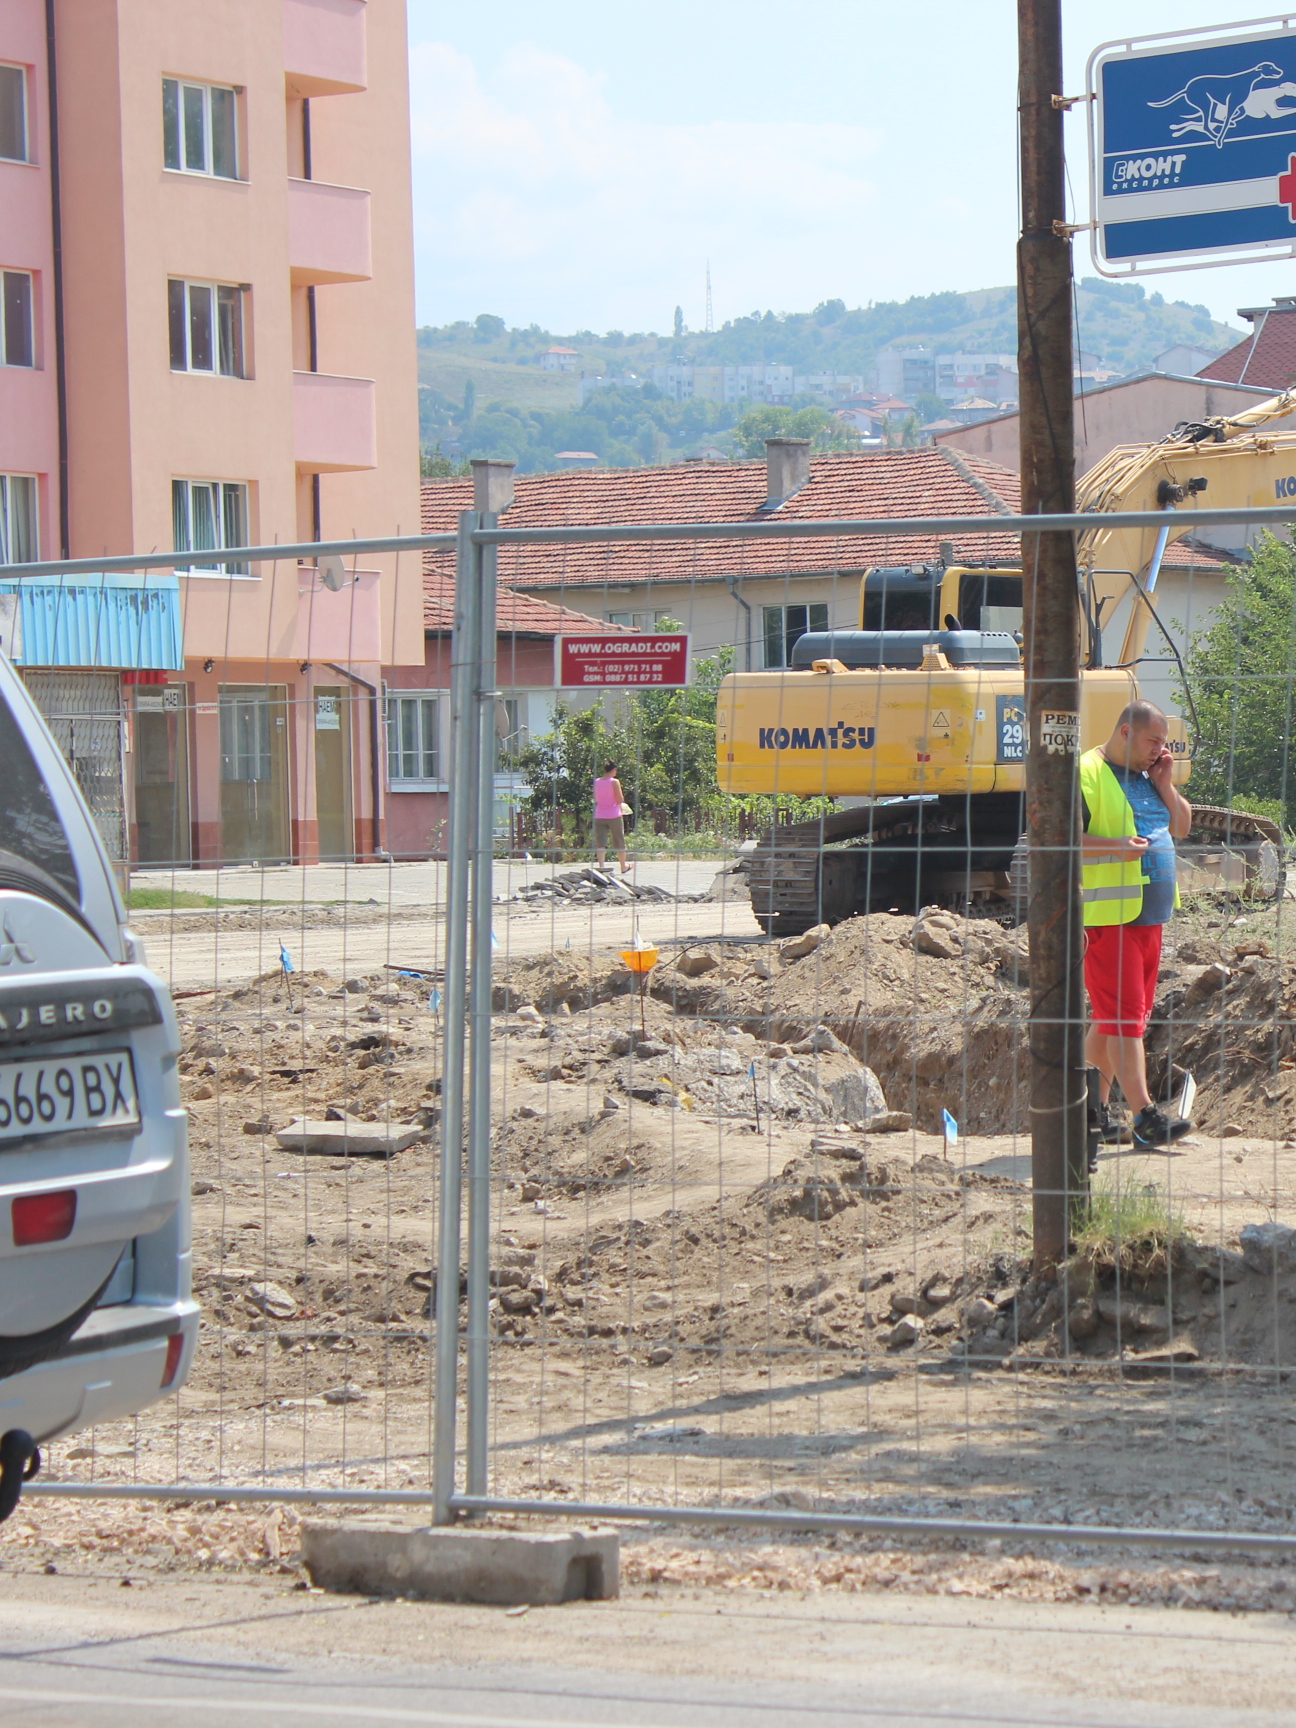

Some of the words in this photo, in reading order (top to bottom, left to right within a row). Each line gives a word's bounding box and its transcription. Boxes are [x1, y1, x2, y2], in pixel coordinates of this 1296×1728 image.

[568, 642, 680, 654] WWW.OGRADI.COM
[604, 664, 622, 673] (02)
[640, 664, 651, 672] 71
[583, 674, 603, 682] GSM:
[627, 674, 637, 682] 51
[639, 674, 651, 682] 87
[652, 674, 663, 682] 32
[1003, 708, 1018, 722] PC
[1044, 713, 1078, 726] РЕМ
[759, 721, 875, 750] KOMATSU
[1002, 724, 1023, 744] 29
[1043, 733, 1077, 747] ПОК
[1003, 746, 1023, 758] NLC
